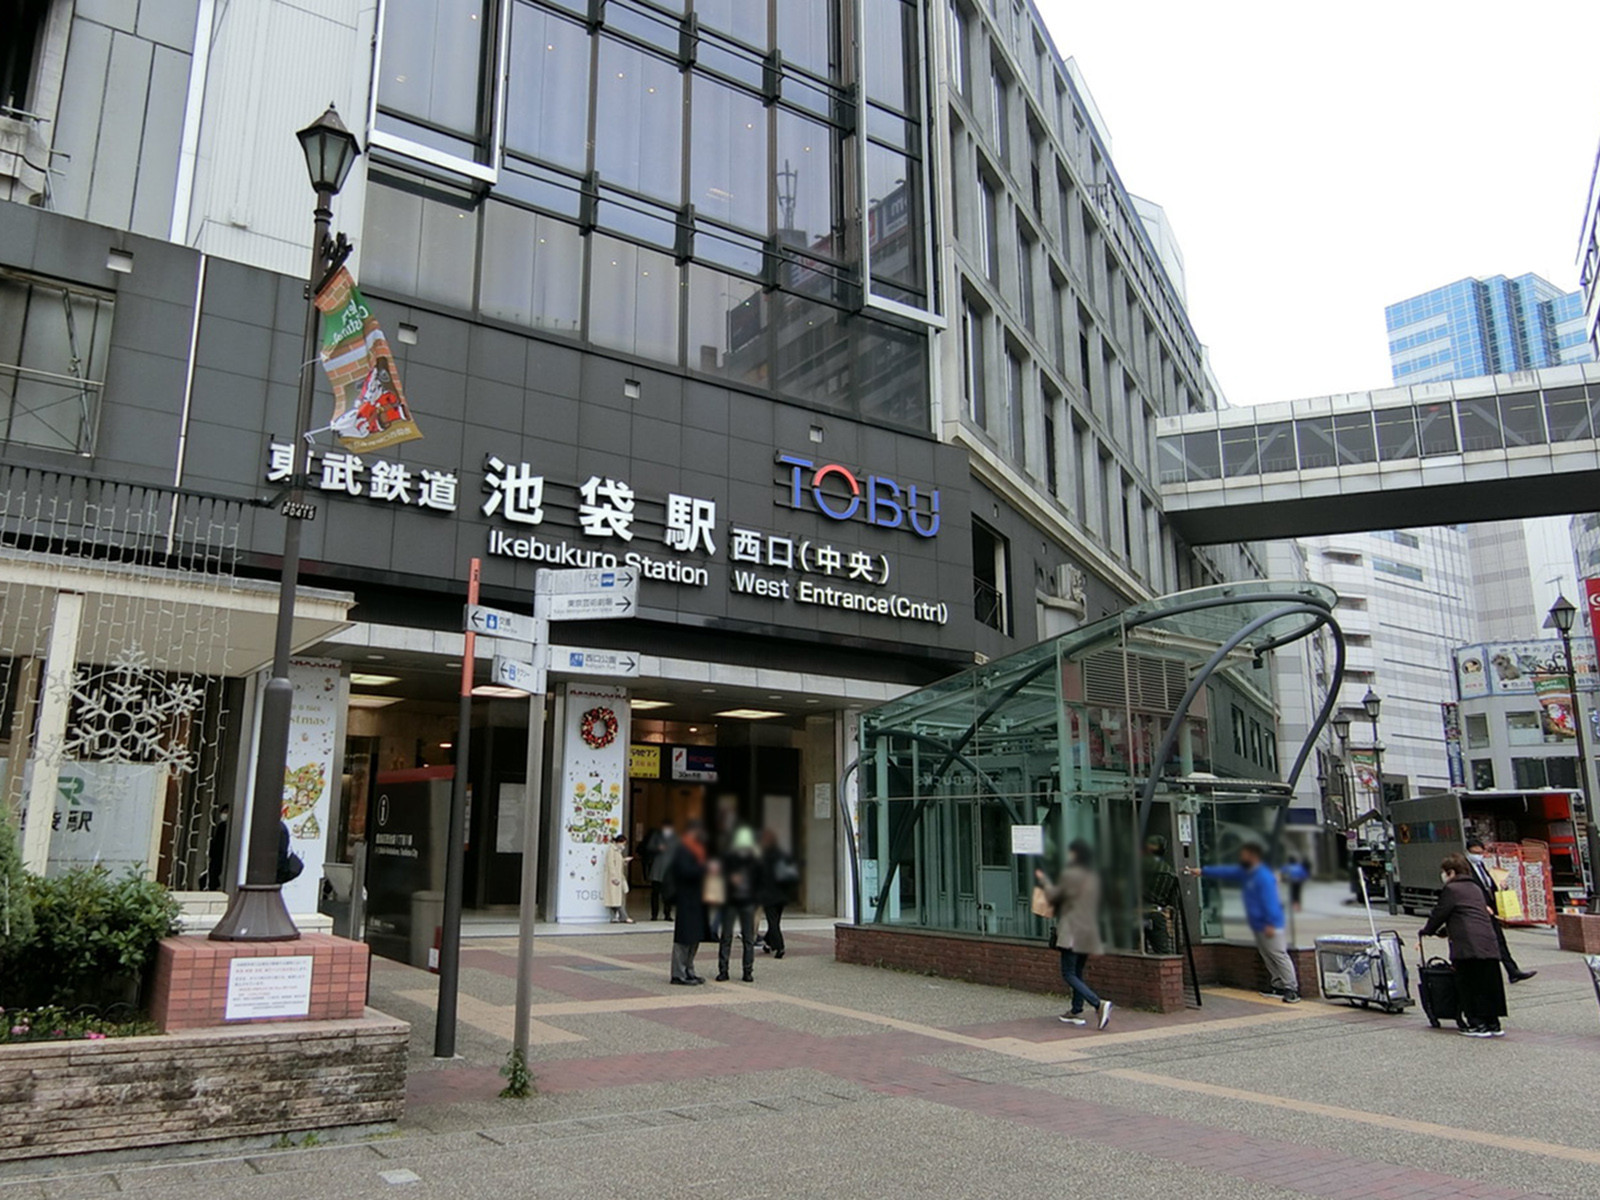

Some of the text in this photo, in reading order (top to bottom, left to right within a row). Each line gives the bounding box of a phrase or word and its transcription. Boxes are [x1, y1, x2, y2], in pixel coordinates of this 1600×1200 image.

[481, 457, 717, 556] 池袋駅
[780, 454, 940, 538] TOBU
[488, 530, 708, 587] Ikebukuro Station
[734, 570, 790, 599] West
